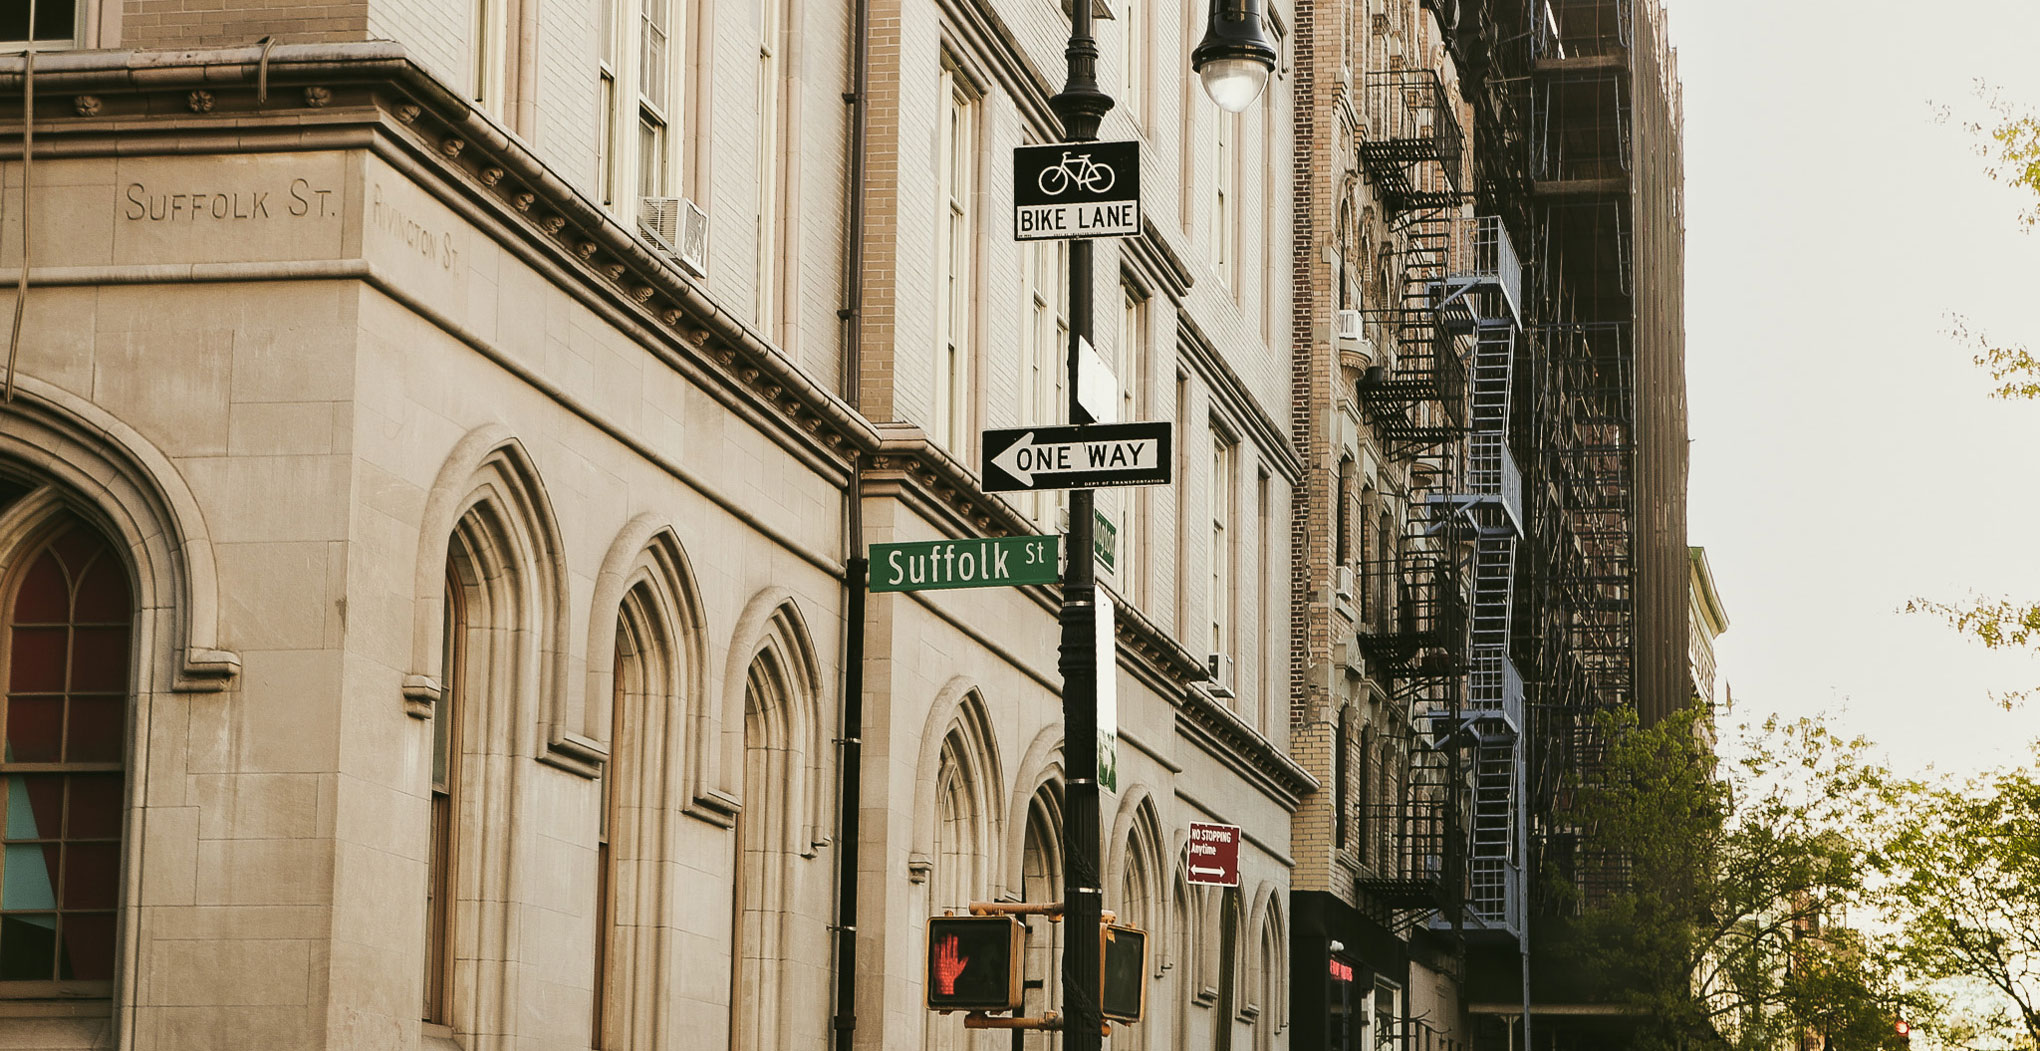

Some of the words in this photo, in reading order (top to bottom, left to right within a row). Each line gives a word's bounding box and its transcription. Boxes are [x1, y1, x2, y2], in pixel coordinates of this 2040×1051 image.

[125, 182, 270, 222] SUFFOLK
[287, 177, 336, 218] ST.
[1021, 207, 1067, 232] BIKE
[1078, 204, 1134, 229] LANE
[1016, 445, 1072, 472] ONE
[1087, 442, 1146, 468] WAY
[887, 542, 1010, 586] Suffolk
[1024, 541, 1046, 565] St
[1191, 829, 1200, 840] NO
[1201, 830, 1231, 843] STOPPING
[1191, 842, 1216, 856] Anytime
